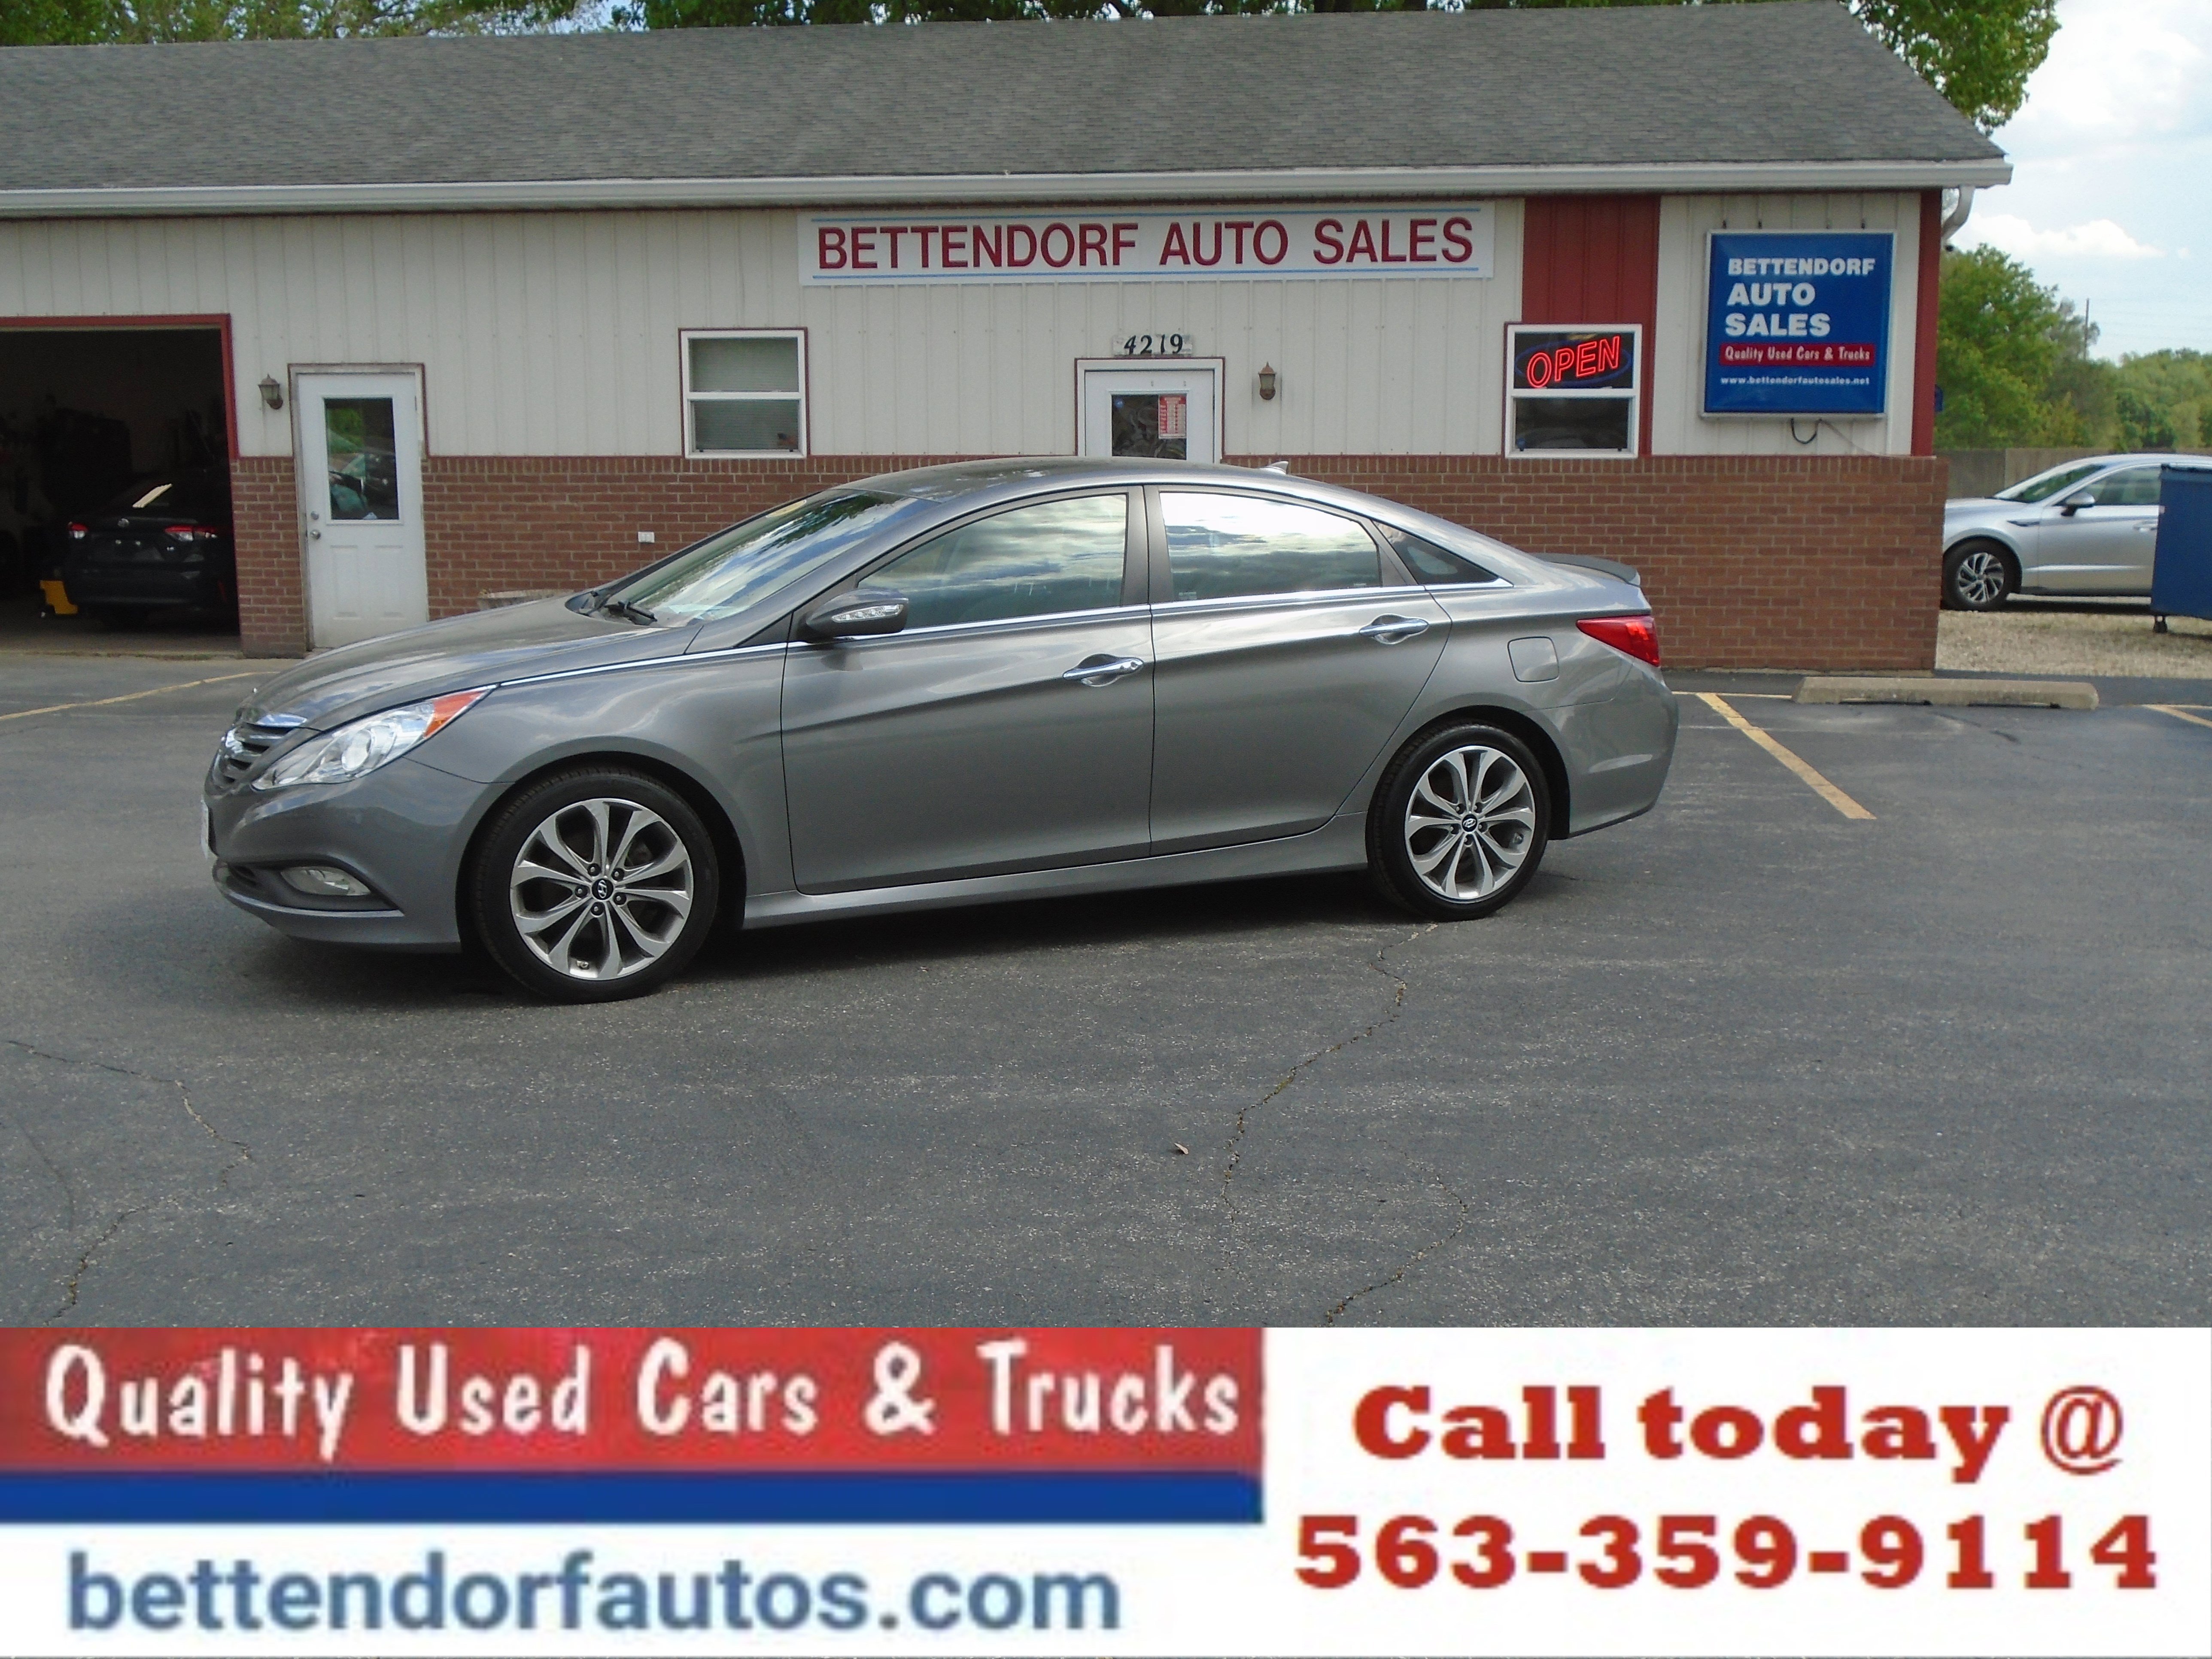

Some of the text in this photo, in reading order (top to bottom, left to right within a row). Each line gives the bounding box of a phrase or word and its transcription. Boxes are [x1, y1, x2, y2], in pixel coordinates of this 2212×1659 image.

[817, 216, 1473, 269] BETTENDORF AUTO SALES
[1728, 258, 1876, 276] BETTENDORF
[1726, 282, 1816, 306] AUTO
[1725, 313, 1831, 337] SALES
[1123, 333, 1184, 355] 4219
[1725, 346, 1870, 363] Quality Used Cars & Trucks
[1526, 334, 1622, 389] OPEN
[1721, 376, 1870, 385] www.bettendorfautosales.net
